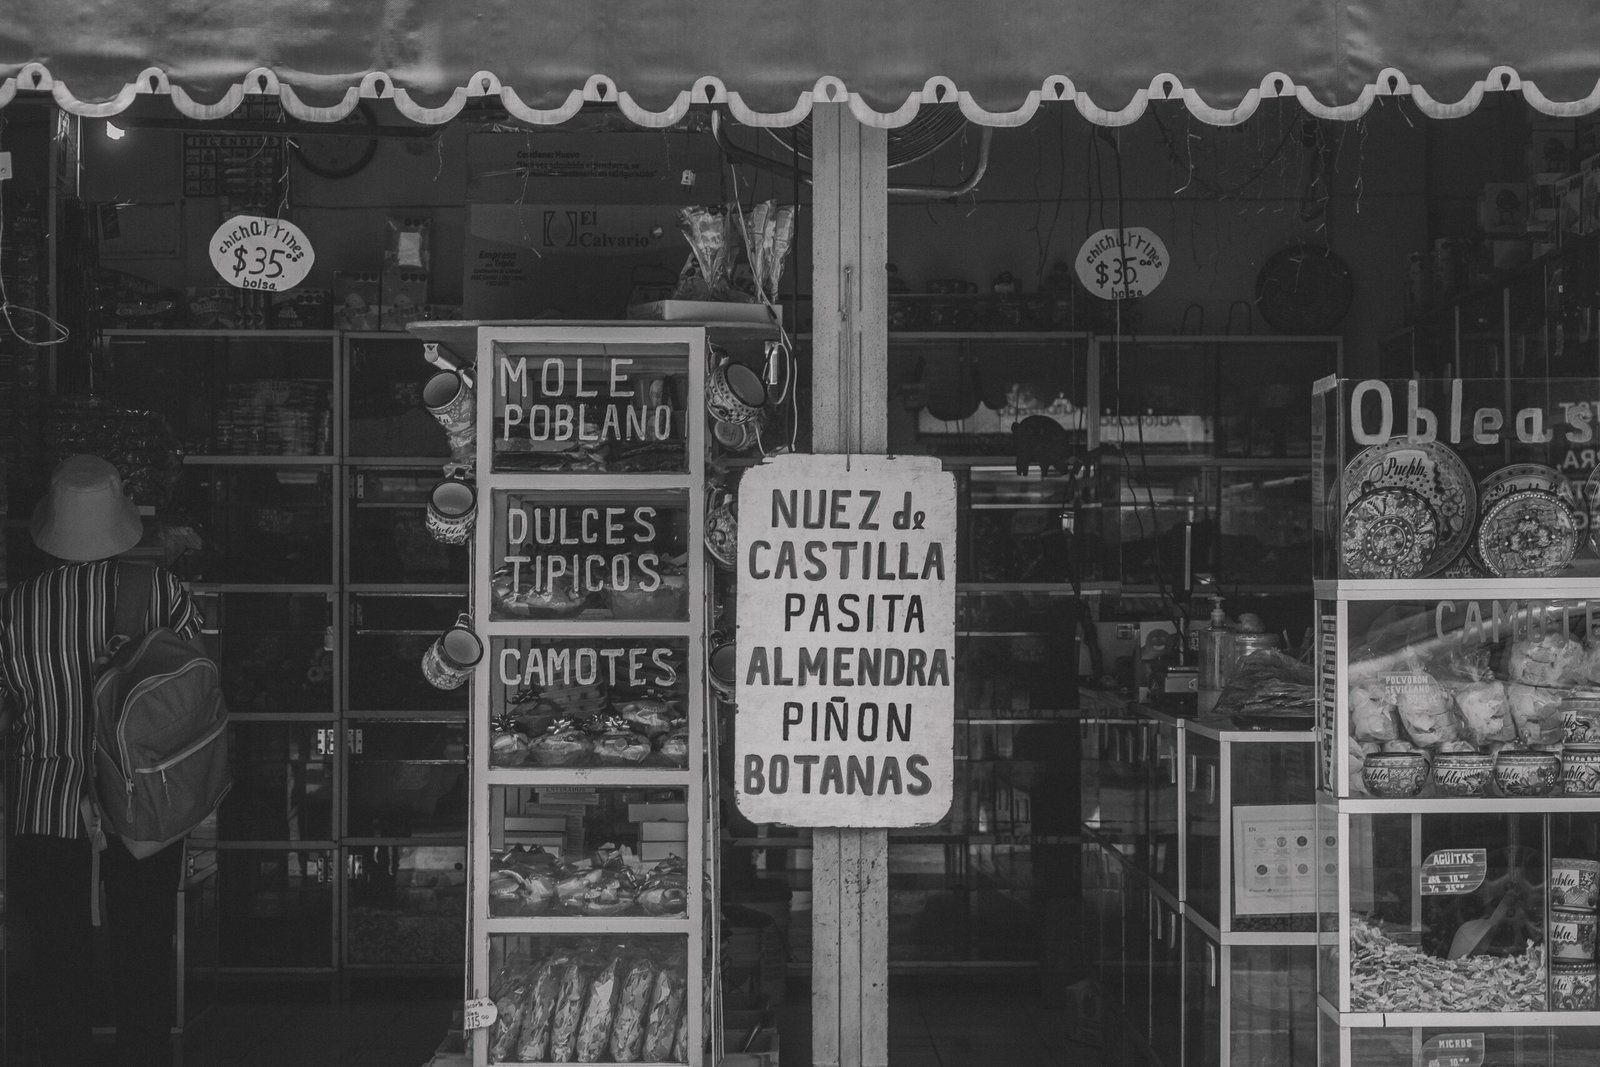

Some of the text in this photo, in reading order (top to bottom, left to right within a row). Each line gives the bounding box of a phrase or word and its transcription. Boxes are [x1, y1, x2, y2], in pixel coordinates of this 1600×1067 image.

[580, 211, 598, 226] El
[219, 220, 304, 260] chicharrines
[579, 232, 649, 248] Calvario
[242, 277, 277, 291] bolsa
[1111, 287, 1143, 299] bosa
[500, 357, 635, 398] MOLE
[503, 404, 671, 441] POBLANO
[1350, 379, 1593, 446] Obleas
[508, 506, 656, 545] DULCES
[771, 489, 925, 530] NUEZ de
[504, 554, 661, 593] TIPICOS
[749, 540, 945, 581] CASTILLA
[784, 593, 925, 633] PASITA
[499, 648, 677, 687] CAMOTES
[745, 646, 950, 687] ALMENDRA
[782, 696, 912, 742] PIÑON
[743, 754, 932, 796] BOTANAS
[1438, 1038, 1473, 1049] MICROS
